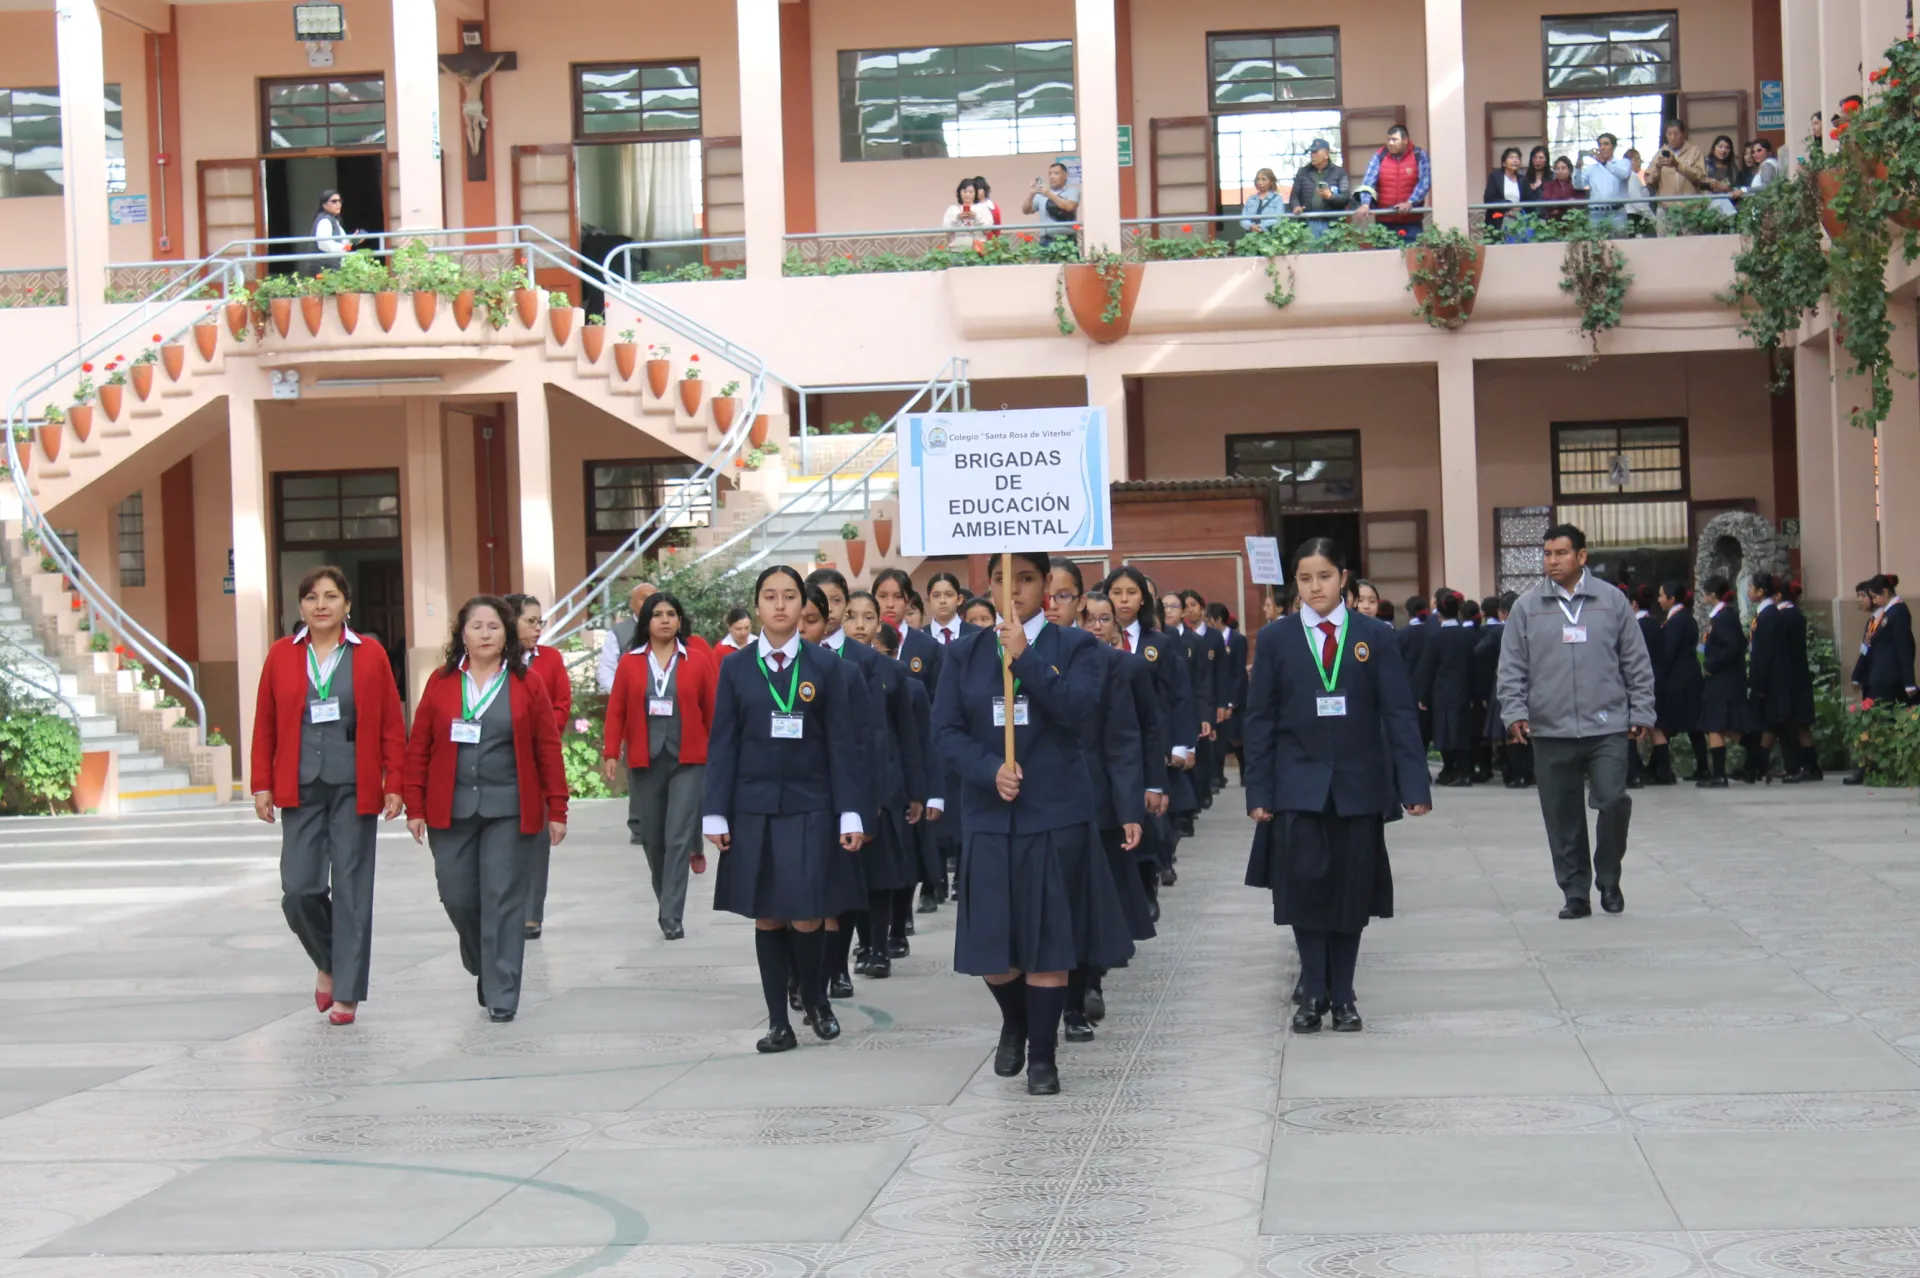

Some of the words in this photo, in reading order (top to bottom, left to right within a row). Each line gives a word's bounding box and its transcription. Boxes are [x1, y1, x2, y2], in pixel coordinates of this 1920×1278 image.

[949, 433, 979, 443] Colegio
[981, 432, 1007, 440] "Santa
[1009, 431, 1028, 439] Rosa
[1030, 430, 1040, 438] de
[1042, 429, 1075, 438] Viterbo"
[955, 450, 1061, 469] BRIGADAS
[995, 474, 1022, 491] DE
[949, 492, 1070, 515] EDUCACIÓN
[952, 519, 1069, 538] AMBIENTAL
